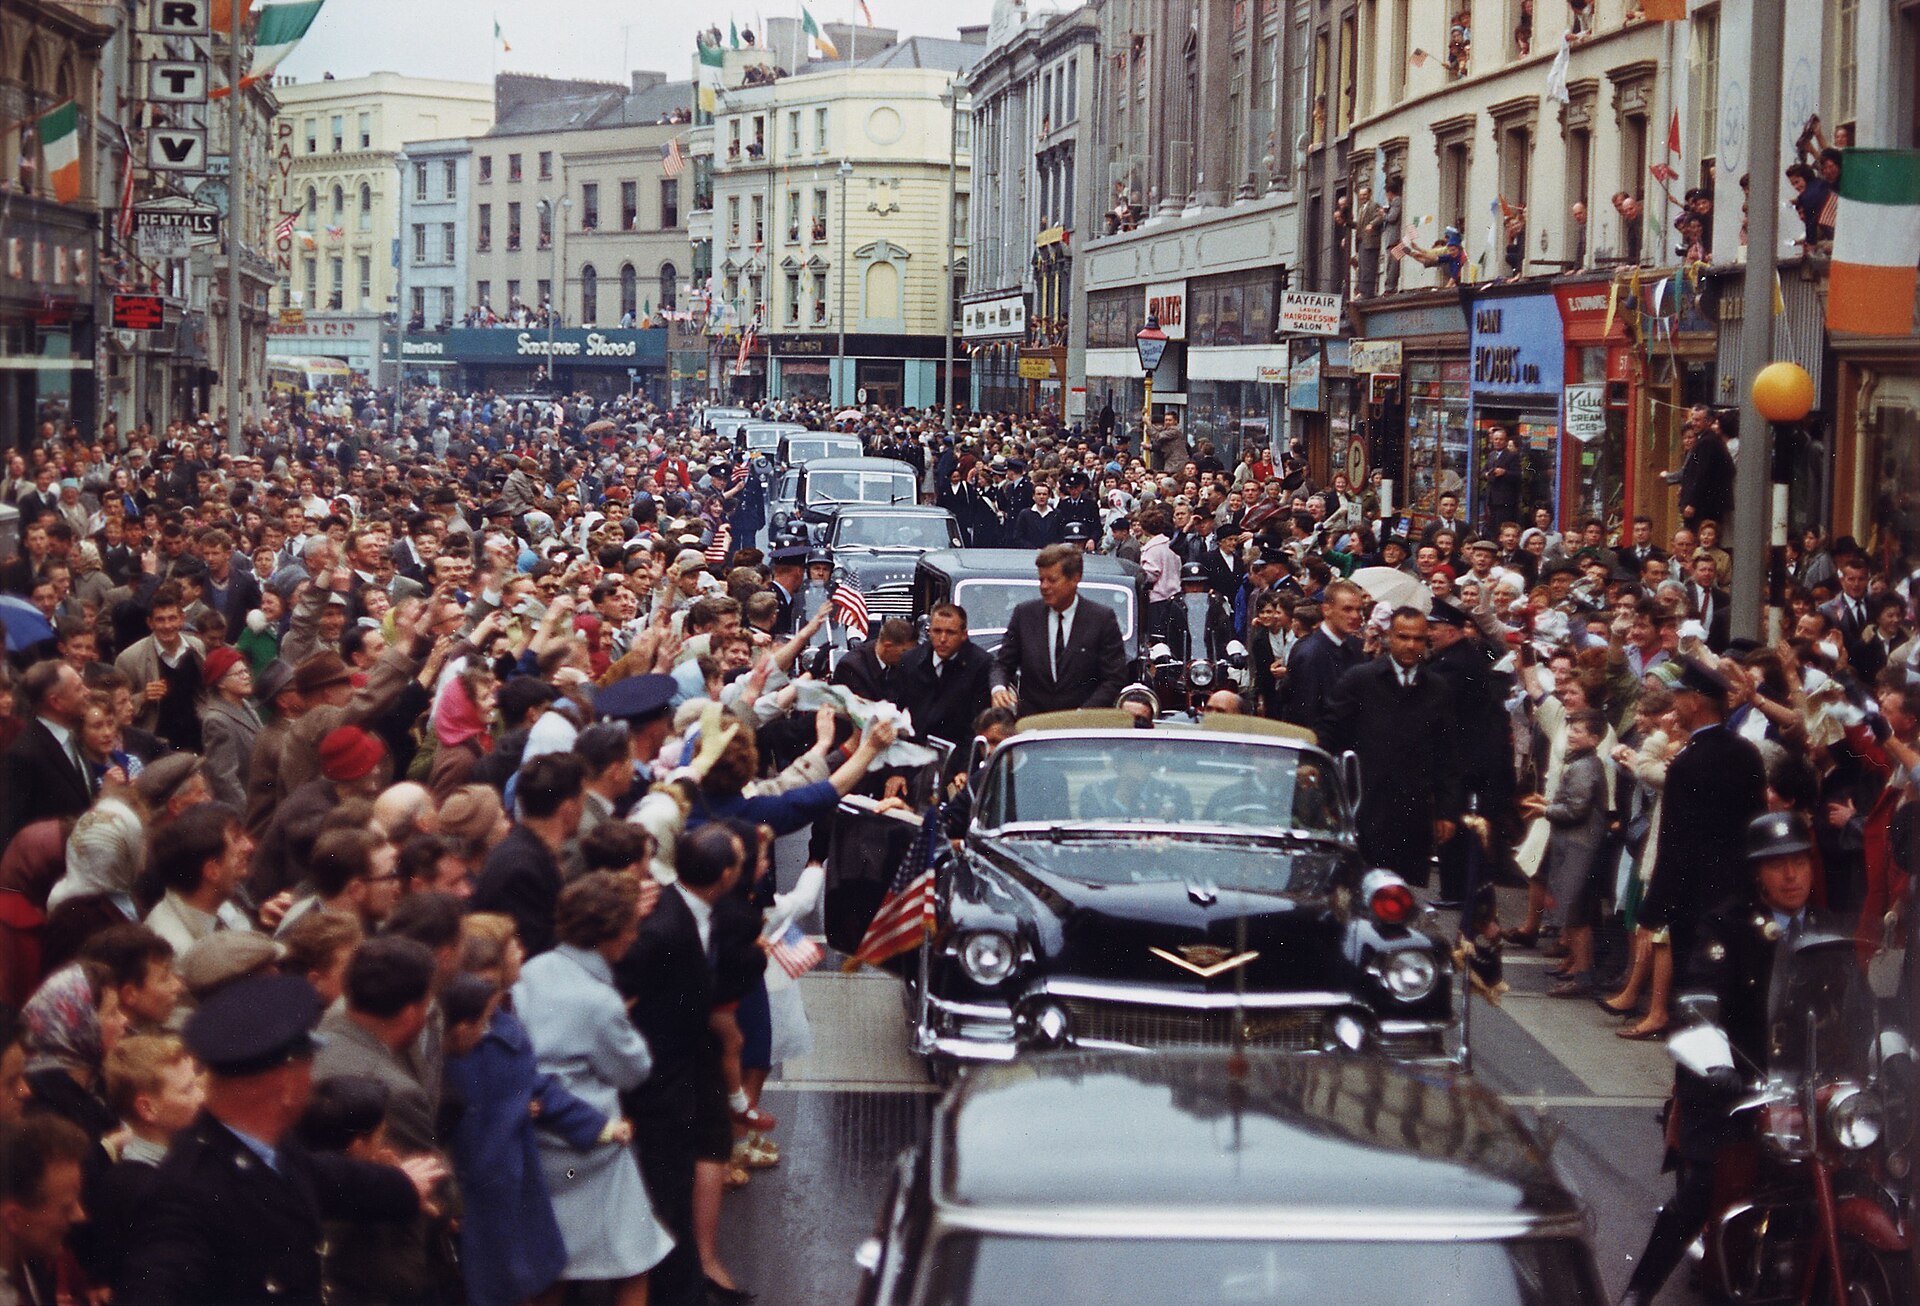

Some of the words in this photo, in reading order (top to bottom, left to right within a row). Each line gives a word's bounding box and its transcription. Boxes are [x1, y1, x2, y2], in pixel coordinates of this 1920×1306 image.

[277, 123, 293, 271] PAVILON
[137, 213, 212, 232] RENTALS
[1286, 294, 1335, 307] MAYFAIR
[1283, 312, 1338, 323] HAIRDRESSING
[1293, 321, 1322, 330] SALON
[586, 332, 636, 356] Shoes
[1475, 346, 1520, 384] HOBBS
[1571, 414, 1603, 422] CREAM
[1576, 423, 1598, 431] ICES
[1353, 446, 1361, 481] P
